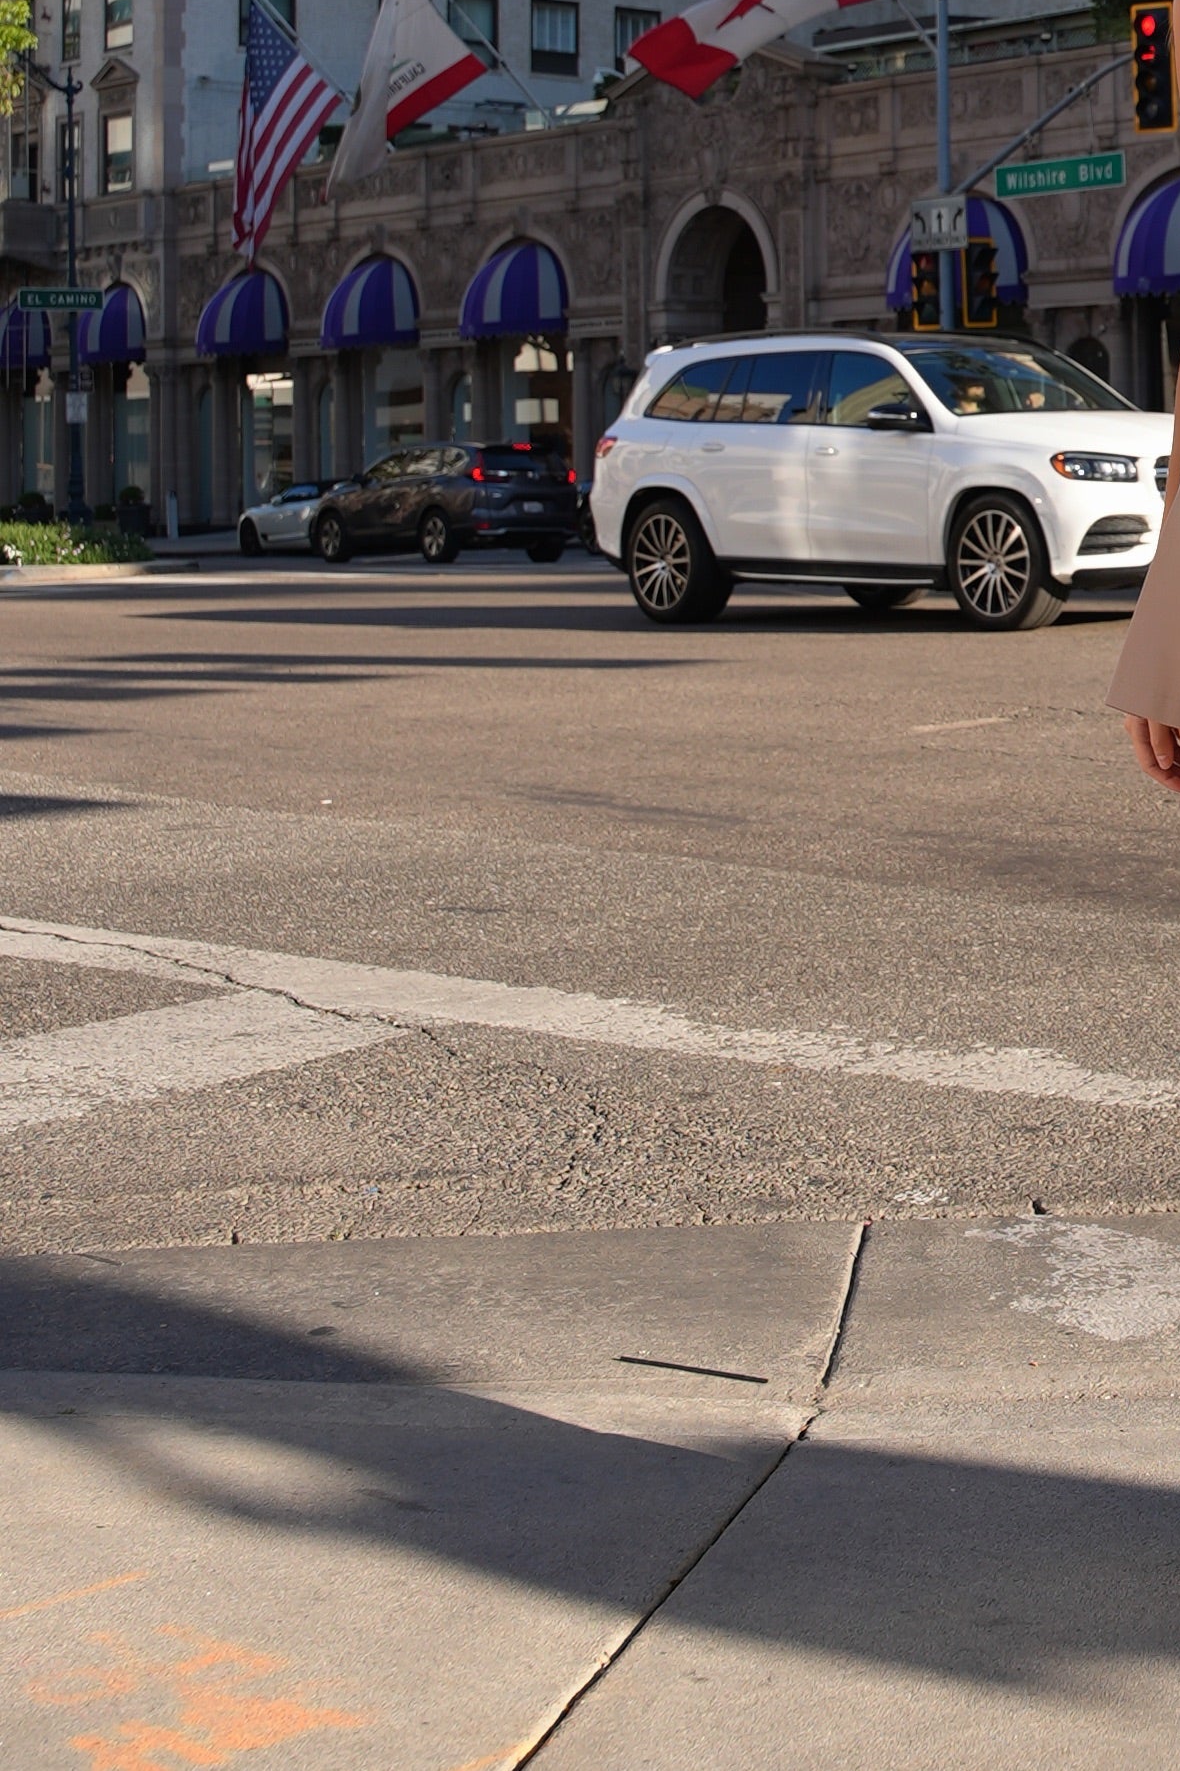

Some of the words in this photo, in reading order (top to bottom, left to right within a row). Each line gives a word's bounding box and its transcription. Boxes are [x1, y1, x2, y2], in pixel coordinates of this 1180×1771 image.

[1006, 169, 1067, 190] Wilshire
[1078, 162, 1113, 182] Blvd
[27, 294, 42, 305] EL
[50, 293, 97, 305] CAMINO
